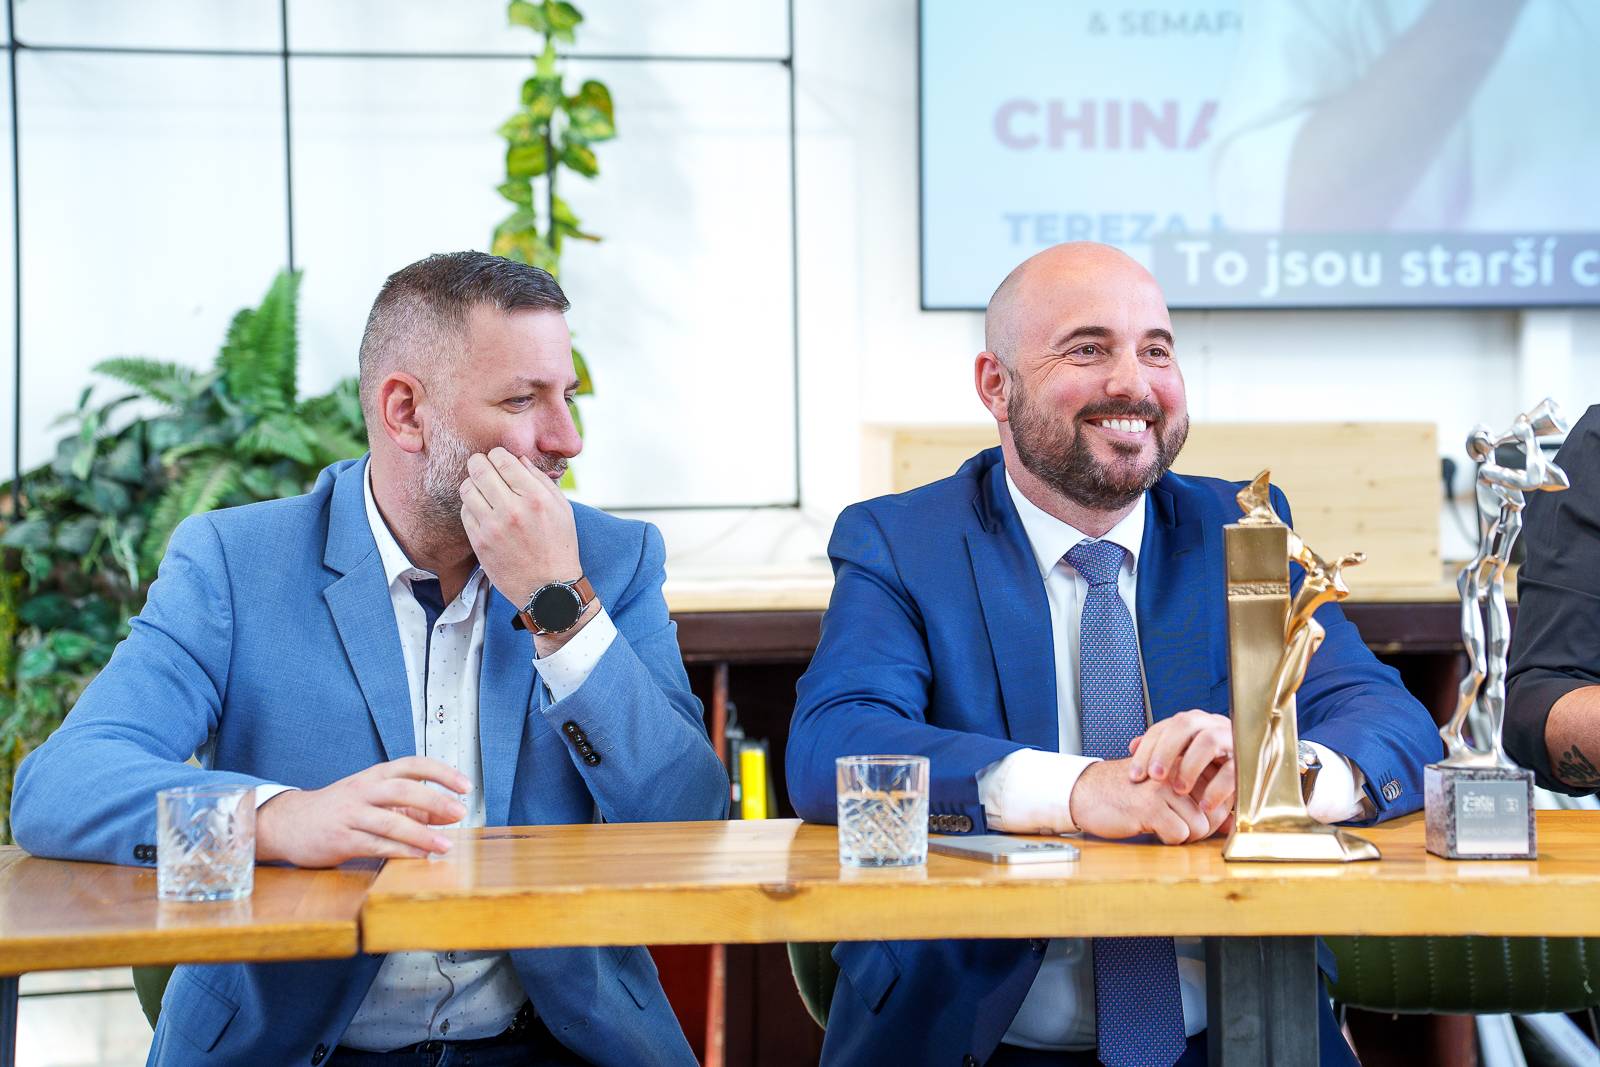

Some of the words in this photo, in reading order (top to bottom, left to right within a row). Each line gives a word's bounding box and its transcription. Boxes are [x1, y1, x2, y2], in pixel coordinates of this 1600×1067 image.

[1119, 10, 1243, 37] SEMAF
[1174, 241, 1248, 287] To
[1260, 239, 1382, 298] jsou
[1401, 237, 1558, 287] starší
